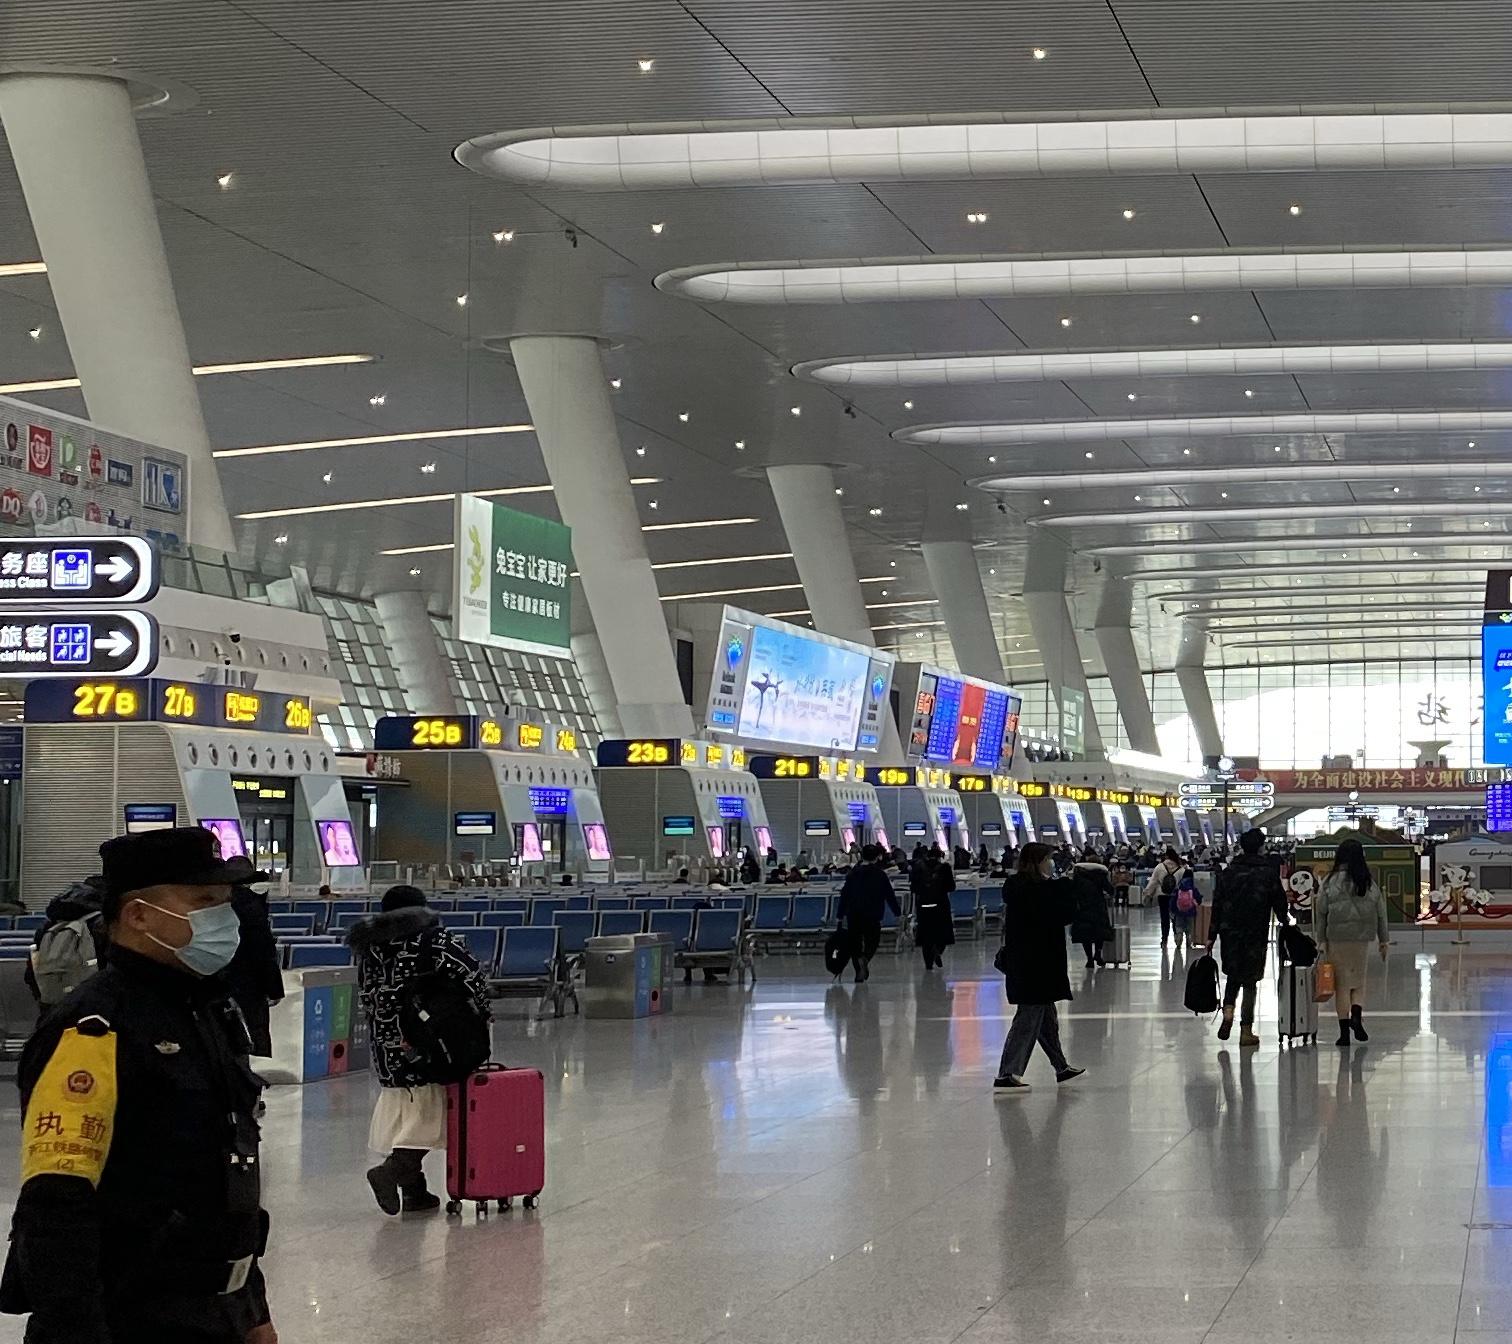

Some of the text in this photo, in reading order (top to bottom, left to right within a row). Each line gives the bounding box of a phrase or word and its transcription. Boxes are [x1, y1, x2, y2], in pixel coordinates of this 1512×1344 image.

[2, 495, 21, 517] DQ
[496, 546, 567, 588] 兔宝宝 让家更好
[17, 576, 48, 588] Class
[0, 625, 48, 648] 旅客
[17, 649, 48, 661] Needs
[73, 685, 137, 716] 27B
[164, 686, 194, 717] 27B
[286, 700, 311, 728] 26B
[412, 720, 462, 745] 25B
[628, 742, 669, 763] 23B
[774, 759, 810, 776] 21B
[878, 769, 909, 785] 19B
[957, 777, 986, 791] 17B
[1020, 783, 1044, 797] 15B
[1070, 788, 1091, 800] 13B
[35, 1111, 107, 1143] 执勤
[56, 1158, 75, 1171] (2)
